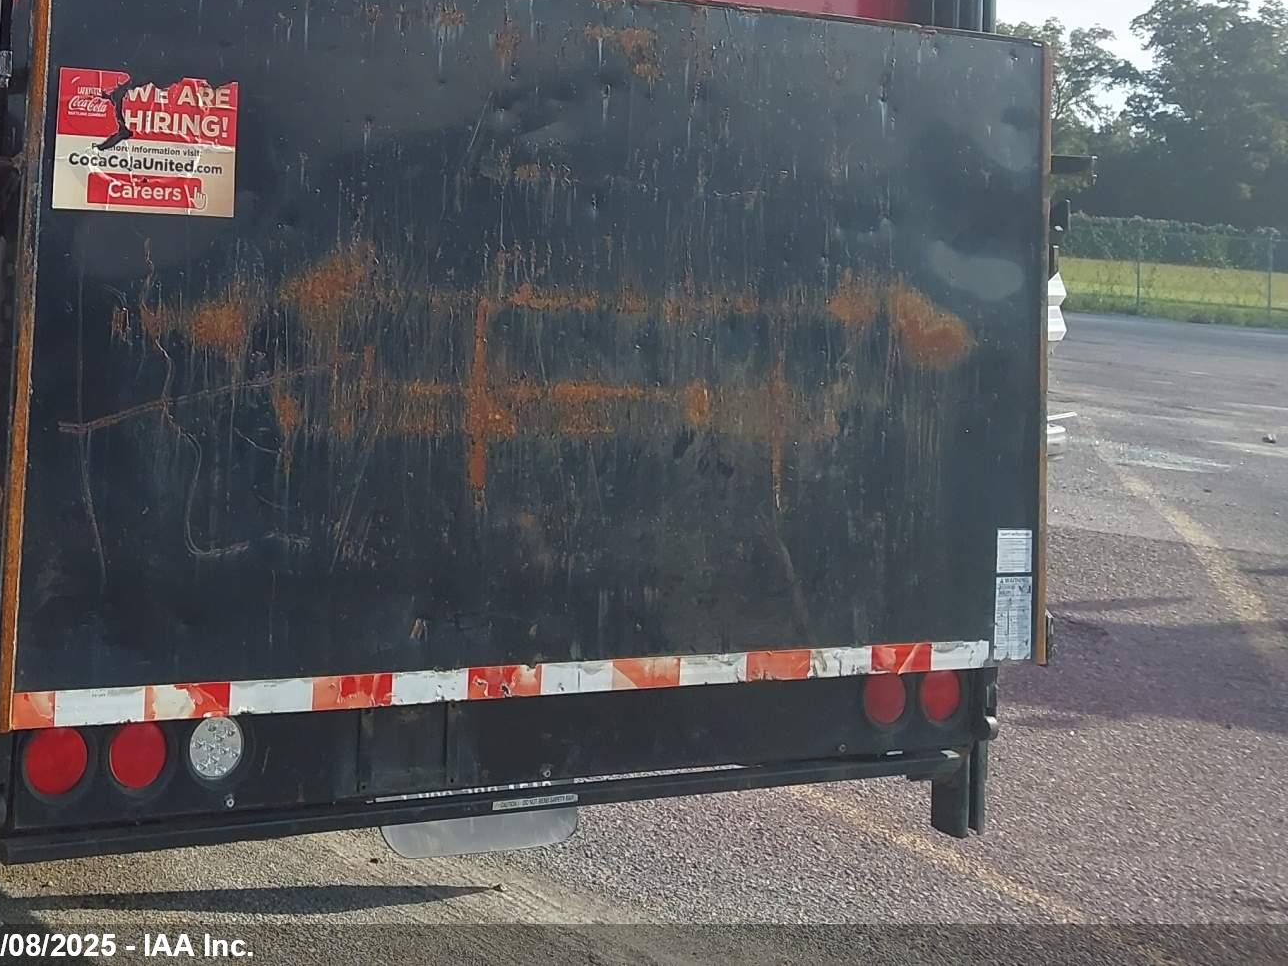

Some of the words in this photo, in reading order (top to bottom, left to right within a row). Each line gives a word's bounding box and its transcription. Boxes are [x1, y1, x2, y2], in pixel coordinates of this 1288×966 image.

[127, 86, 169, 104] WE
[177, 85, 231, 107] ARE
[125, 109, 229, 138] HIRING!
[68, 152, 223, 176] CocaColaUnited.com
[108, 180, 182, 201] Careers
